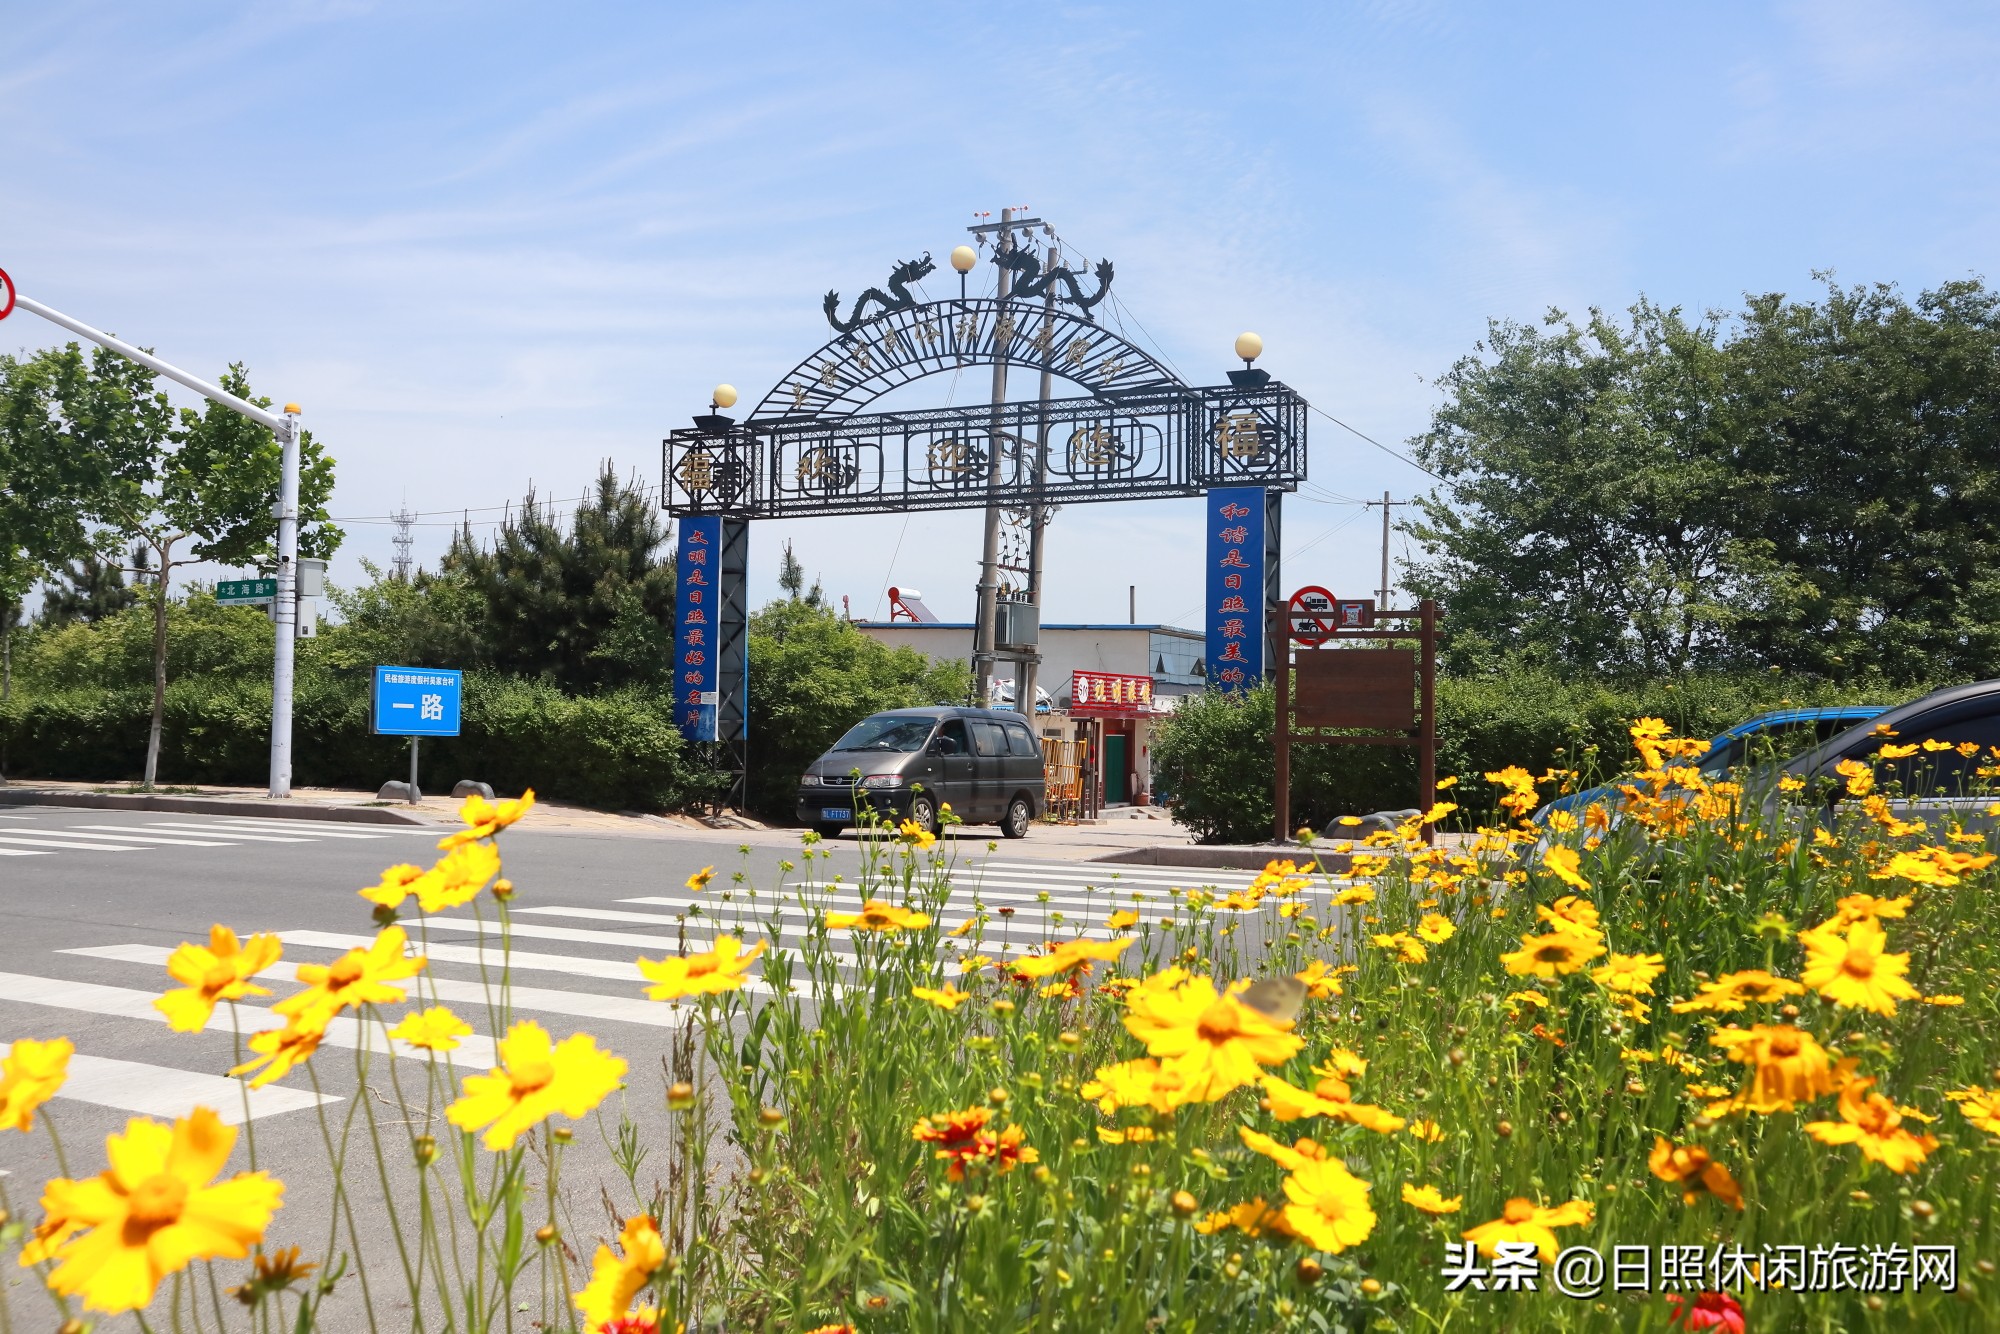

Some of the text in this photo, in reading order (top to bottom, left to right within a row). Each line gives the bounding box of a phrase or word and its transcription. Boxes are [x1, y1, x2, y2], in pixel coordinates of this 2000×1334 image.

[794, 422, 1116, 481] 欢迎您
[1215, 412, 1259, 459] 福
[679, 451, 712, 492] 福
[227, 582, 265, 596] 北海路
[683, 529, 709, 728] 文明是日照最好的名片
[384, 673, 455, 687] 民俗旅游度假村吴家台村
[392, 693, 444, 721] 一路
